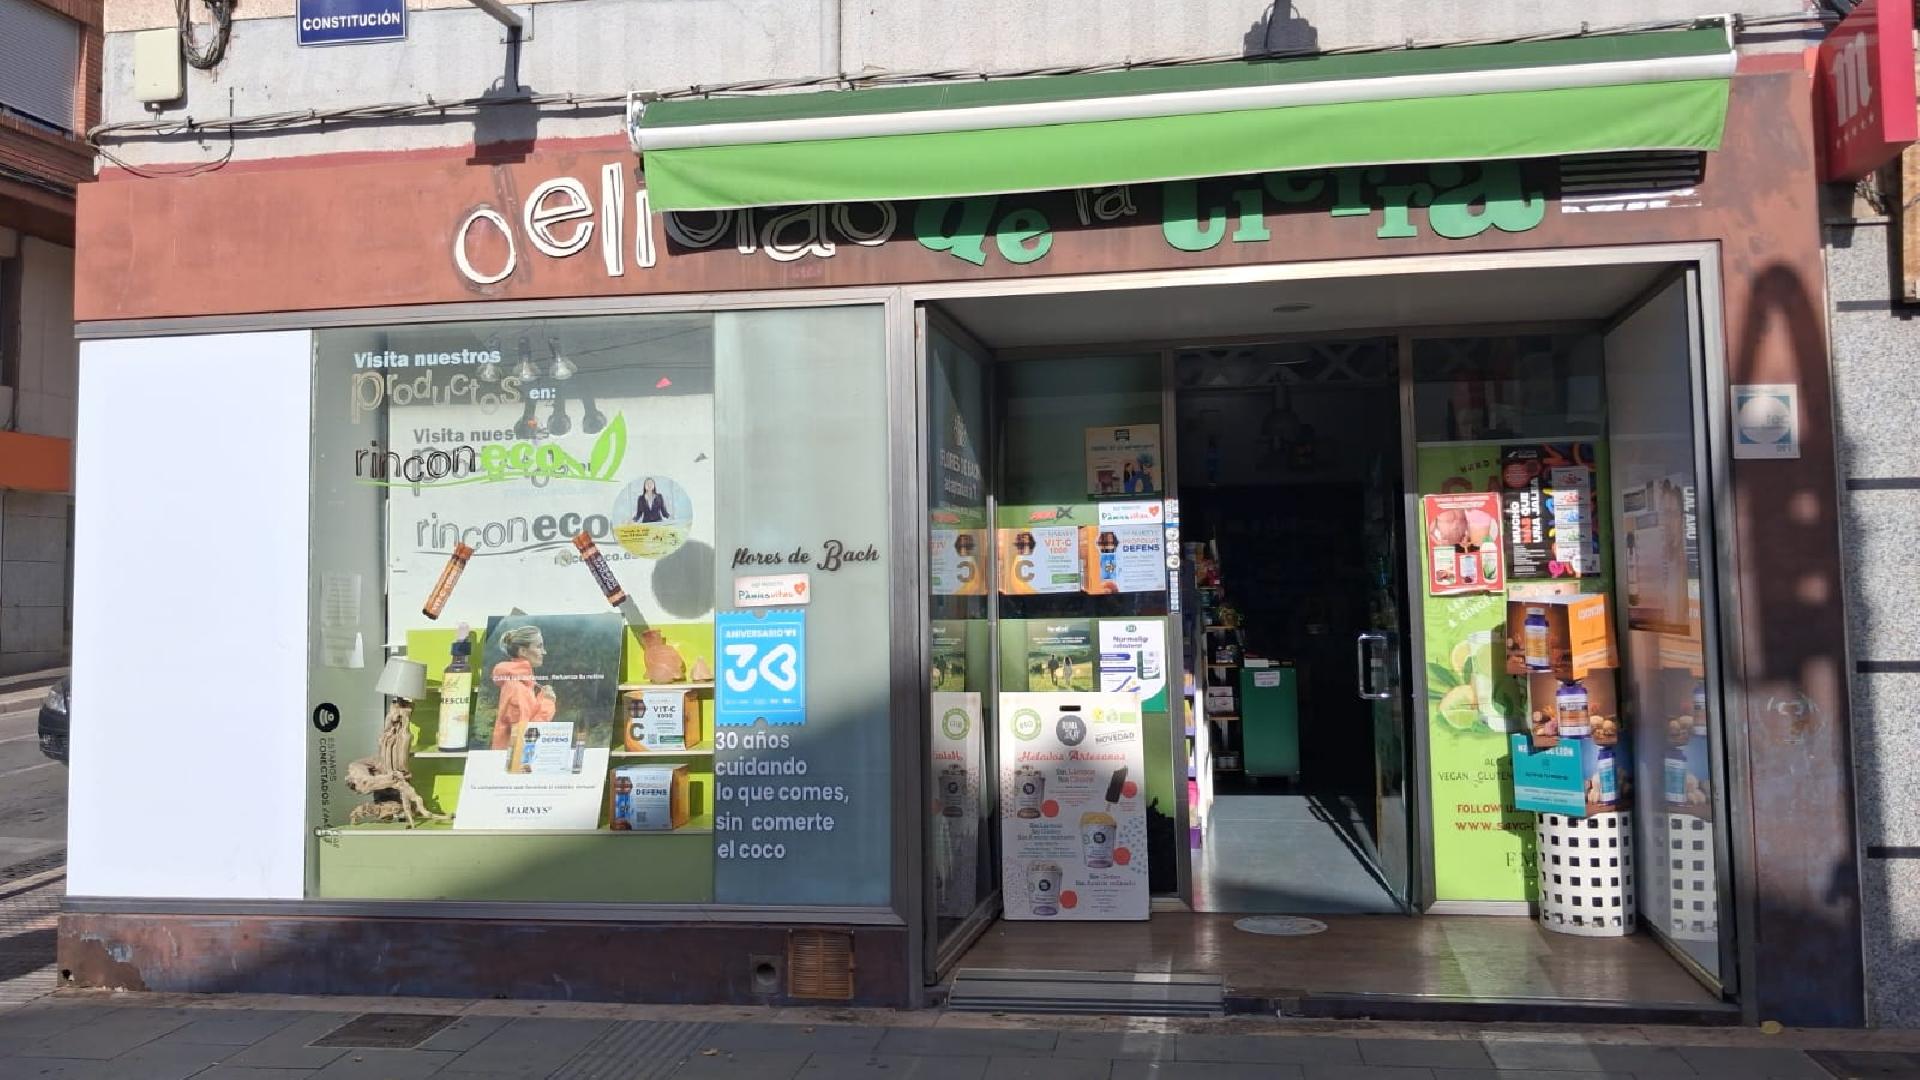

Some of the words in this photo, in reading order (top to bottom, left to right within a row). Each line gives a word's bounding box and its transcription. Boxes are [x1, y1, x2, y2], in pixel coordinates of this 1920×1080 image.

[303, 8, 400, 31] CONSTITUCIÓN
[354, 351, 409, 368] Visita
[414, 349, 501, 367] nuestros
[351, 368, 521, 424] productos
[528, 387, 556, 400] en:
[1511, 500, 1521, 544] MUCHO
[1532, 517, 1543, 543] UNA
[731, 547, 783, 569] flores
[787, 547, 811, 564] de
[816, 539, 880, 572] Bach
[1122, 544, 1160, 553] DEFENS
[715, 731, 738, 749] 30
[743, 730, 790, 749] años
[715, 757, 808, 776] cuidando
[716, 783, 734, 801] lo
[738, 785, 774, 806] que
[778, 784, 849, 804] comes,
[1457, 804, 1501, 814] FOLLOW
[715, 812, 743, 831] sin
[751, 813, 835, 831] comerte
[717, 840, 735, 859] el
[739, 842, 786, 859] coco
